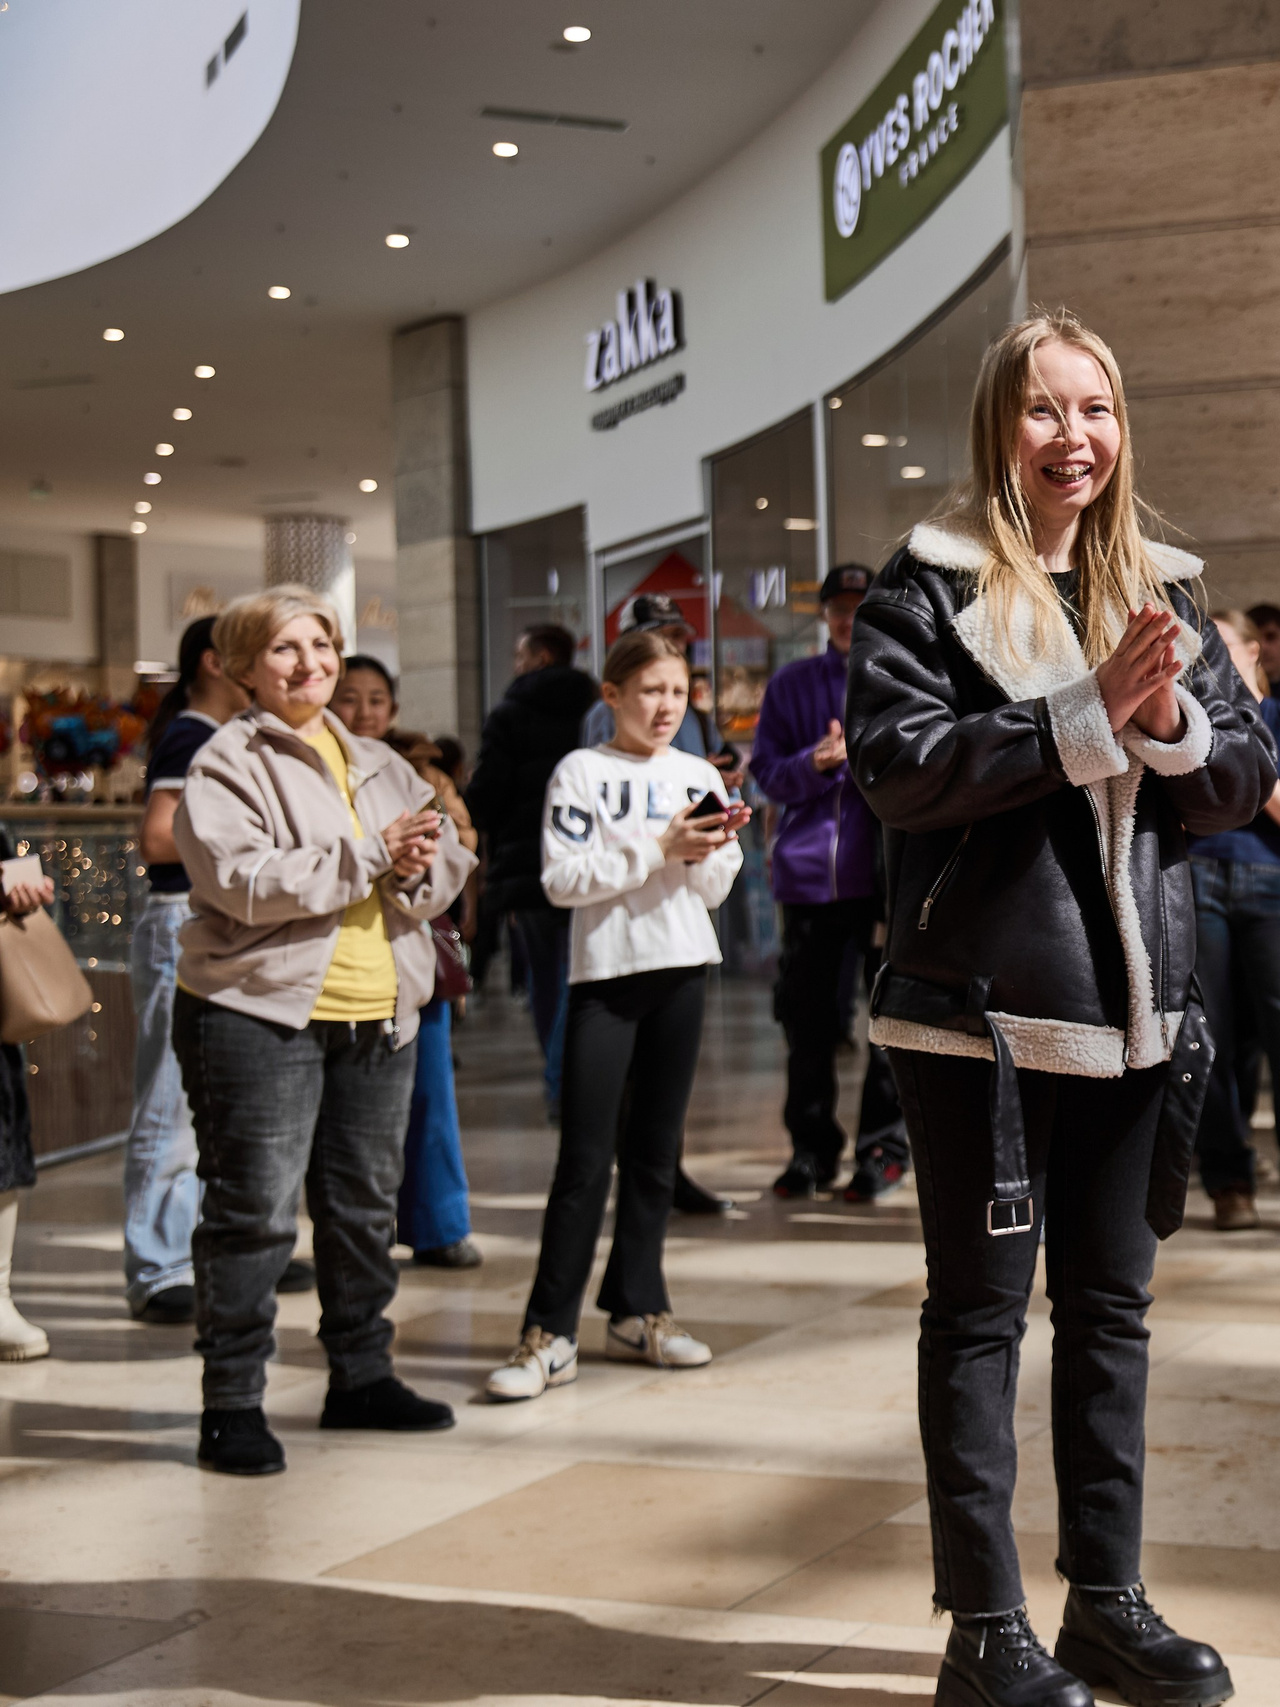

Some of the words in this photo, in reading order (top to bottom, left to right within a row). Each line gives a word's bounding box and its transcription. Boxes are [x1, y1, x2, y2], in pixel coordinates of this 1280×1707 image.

[859, 93, 910, 191] YVES
[912, 0, 995, 132] ROCHER
[900, 102, 959, 187] FRANCE
[584, 278, 679, 392] zakka
